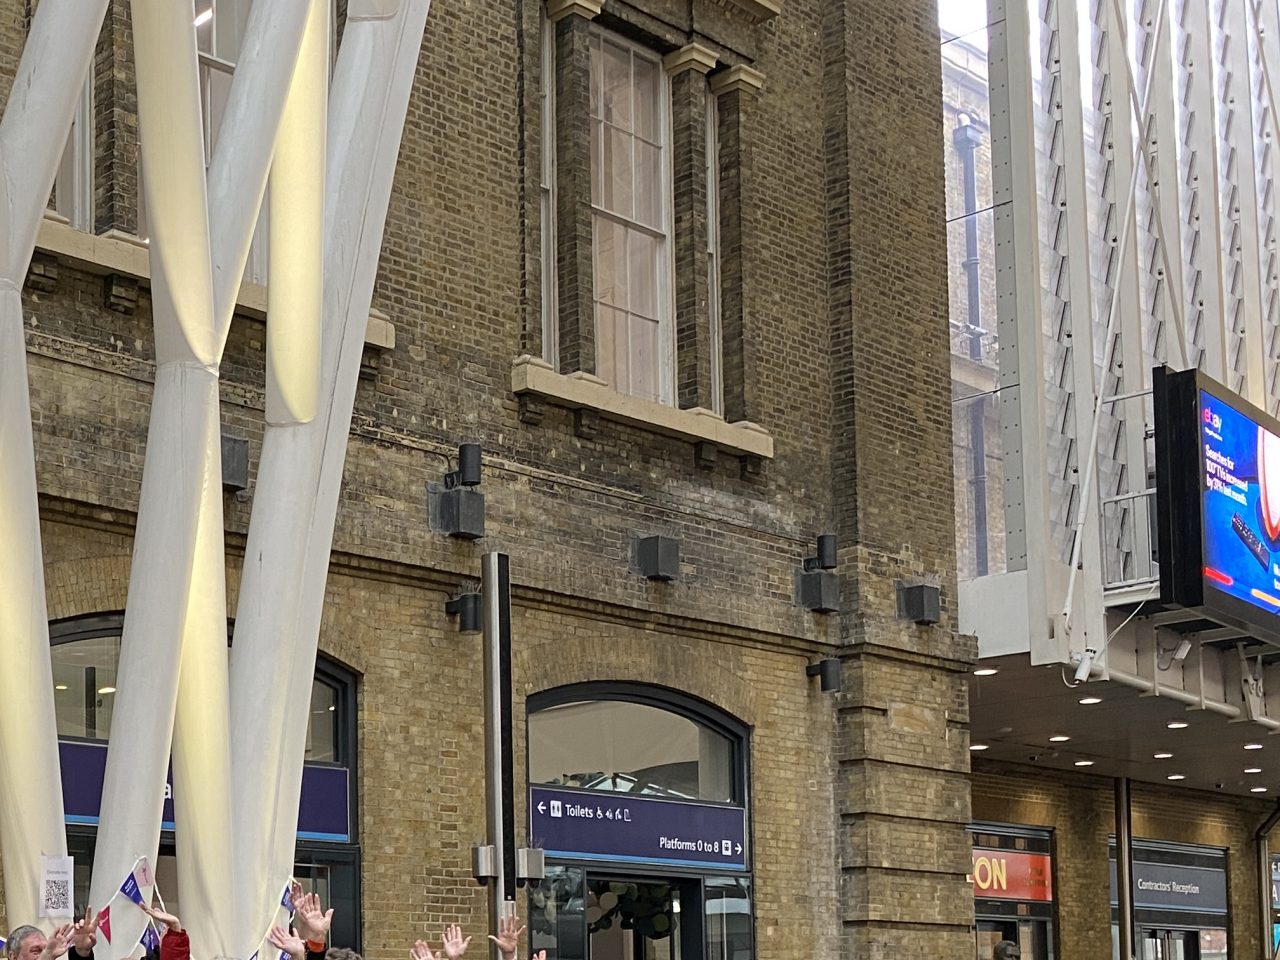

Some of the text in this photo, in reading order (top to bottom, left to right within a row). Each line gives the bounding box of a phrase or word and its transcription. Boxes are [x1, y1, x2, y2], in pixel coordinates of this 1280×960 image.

[565, 804, 593, 817] Toilets
[660, 837, 719, 852] Platforms 0 to 8
[972, 856, 1007, 890] ON
[1172, 882, 1199, 895] Reception
